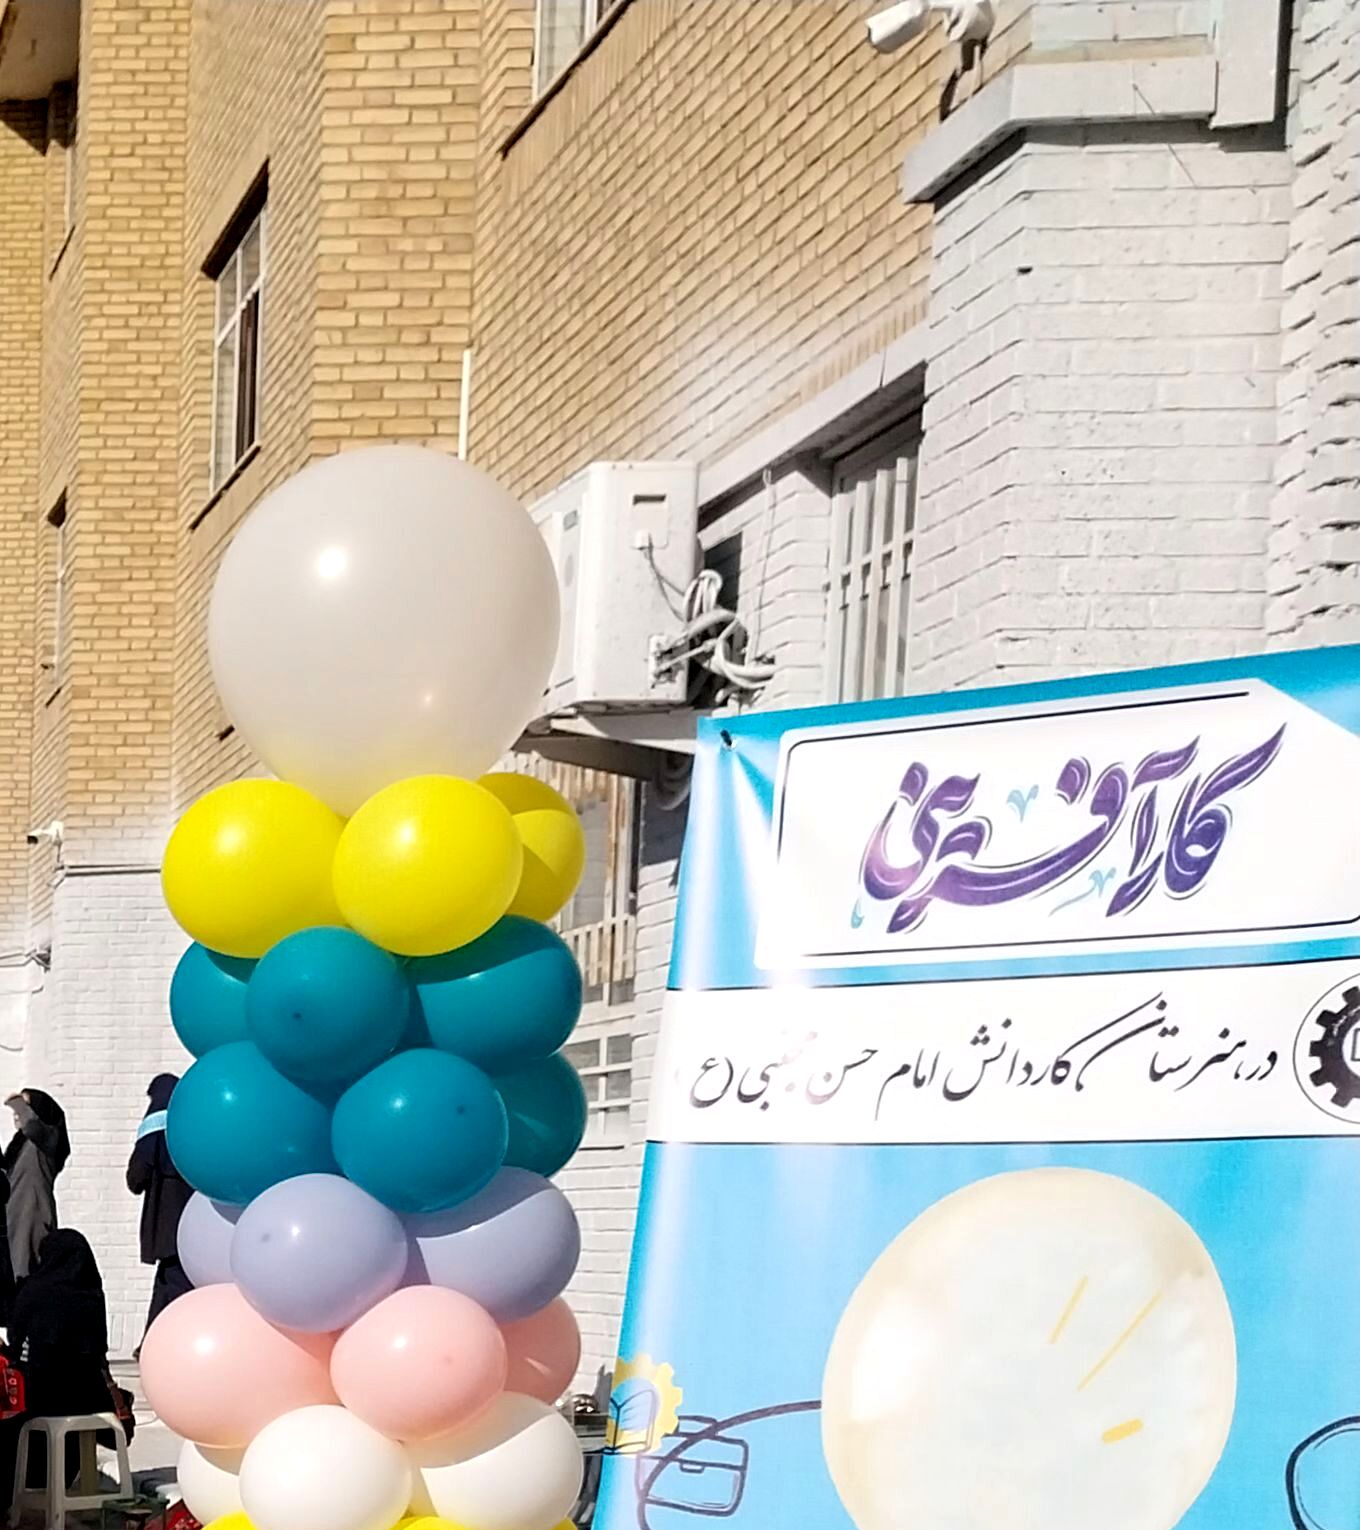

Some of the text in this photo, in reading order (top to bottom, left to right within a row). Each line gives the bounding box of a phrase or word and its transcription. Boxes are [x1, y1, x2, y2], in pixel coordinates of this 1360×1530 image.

[736, 1031, 819, 1112] مجبی
[805, 1048, 880, 1106] حسن
[1077, 999, 1247, 1092] هنرستان
[1245, 1050, 1278, 1081] در
[873, 1047, 941, 1121] امام
